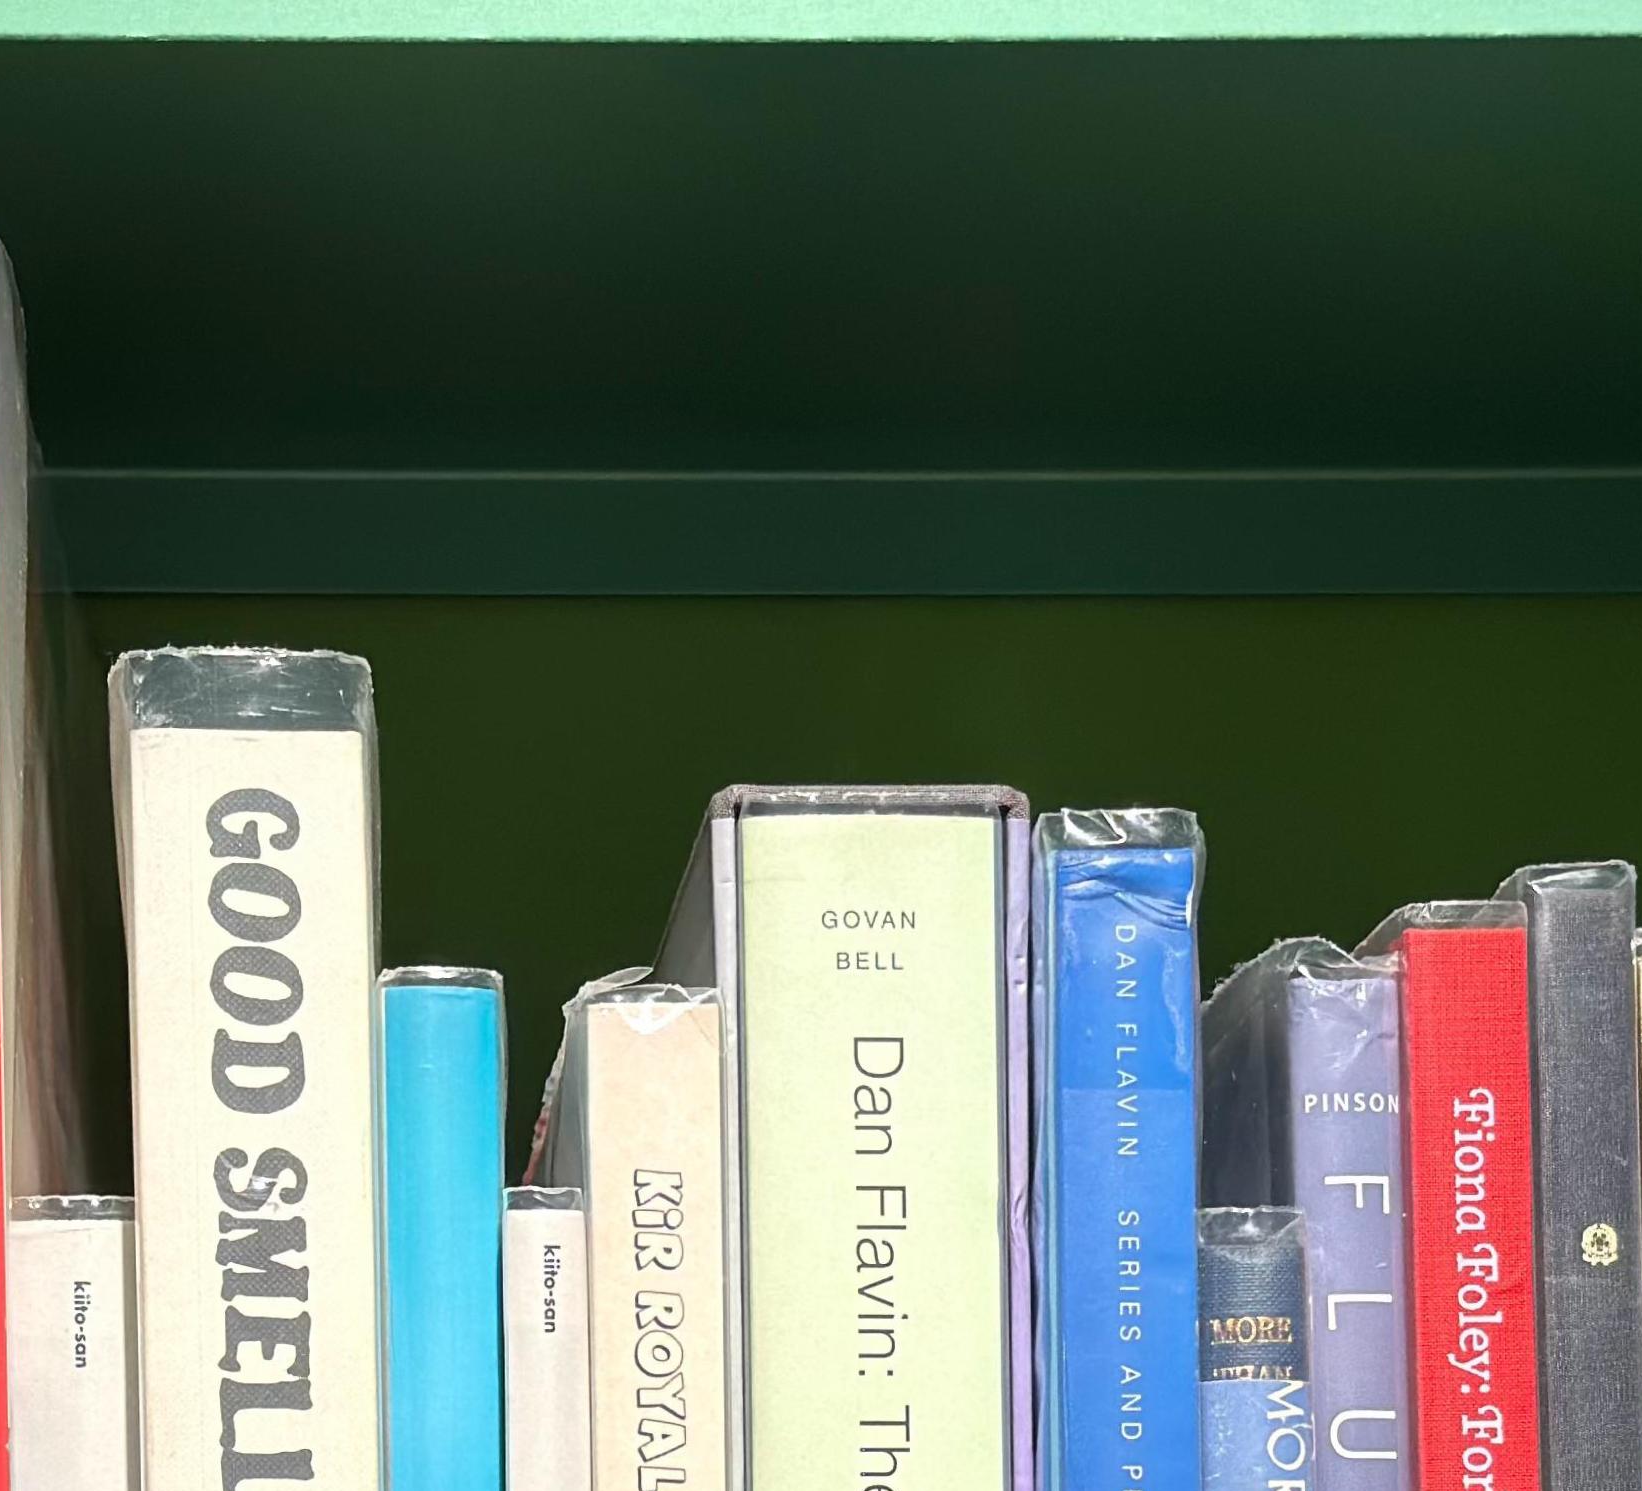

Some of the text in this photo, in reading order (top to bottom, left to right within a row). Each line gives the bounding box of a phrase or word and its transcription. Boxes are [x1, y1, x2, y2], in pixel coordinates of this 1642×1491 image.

[206, 788, 305, 1115] GOOD
[821, 910, 917, 930] GOVAN
[836, 952, 904, 971] BELL
[1113, 924, 1138, 1001] DAN
[851, 1036, 905, 1155] Dan
[1115, 1025, 1139, 1156] FLAVIN
[1304, 1092, 1400, 1114] PINSON
[1453, 1087, 1495, 1233] Fiona
[543, 1243, 562, 1334] kiito-san
[855, 1187, 907, 1378] Flavin:
[1117, 1210, 1141, 1340] SERIES
[1447, 1243, 1502, 1394] Foley:
[73, 1281, 91, 1369] kiito-san
[1210, 1315, 1293, 1344] MORE
[1120, 1367, 1144, 1440] AND
